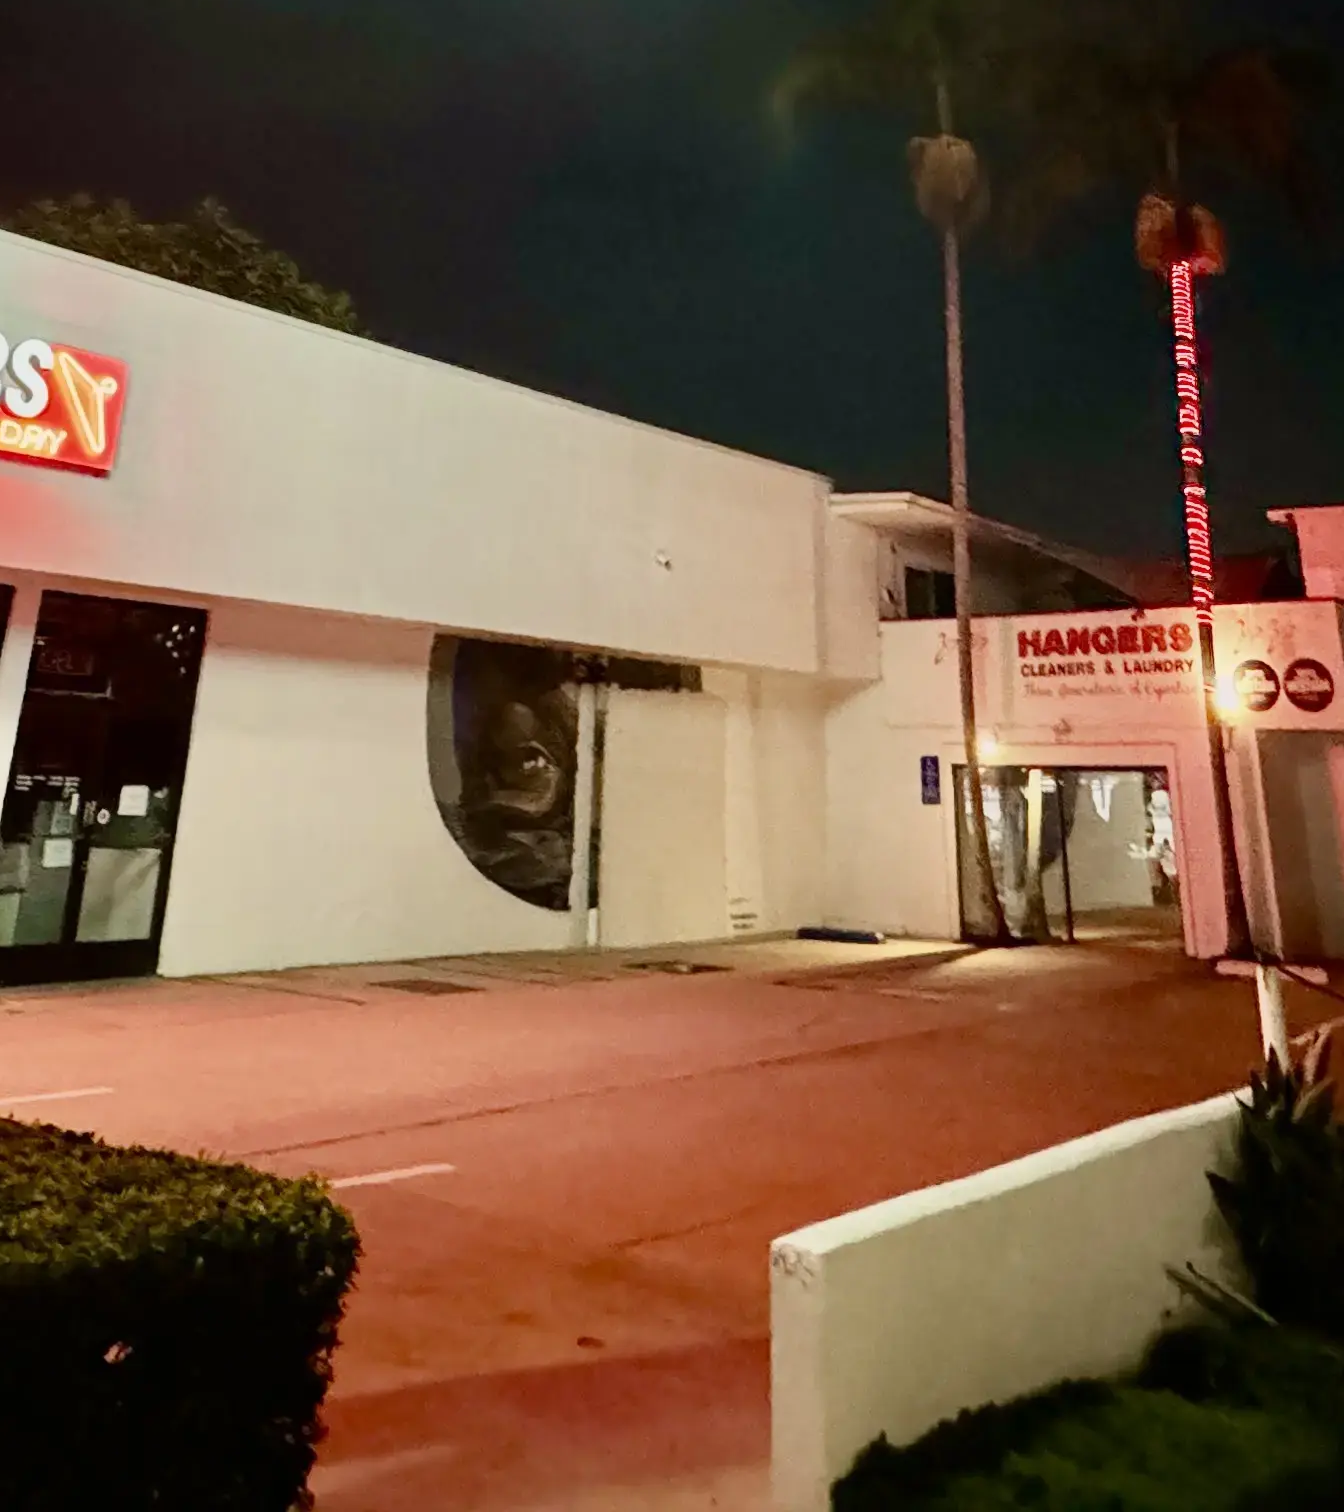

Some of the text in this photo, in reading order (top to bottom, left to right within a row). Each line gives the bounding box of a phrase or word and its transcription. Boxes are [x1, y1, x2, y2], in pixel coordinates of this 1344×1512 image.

[1017, 622, 1194, 658] HANGERS
[1020, 659, 1096, 678] CLEANERS
[1123, 659, 1194, 675] LAUNDRY
